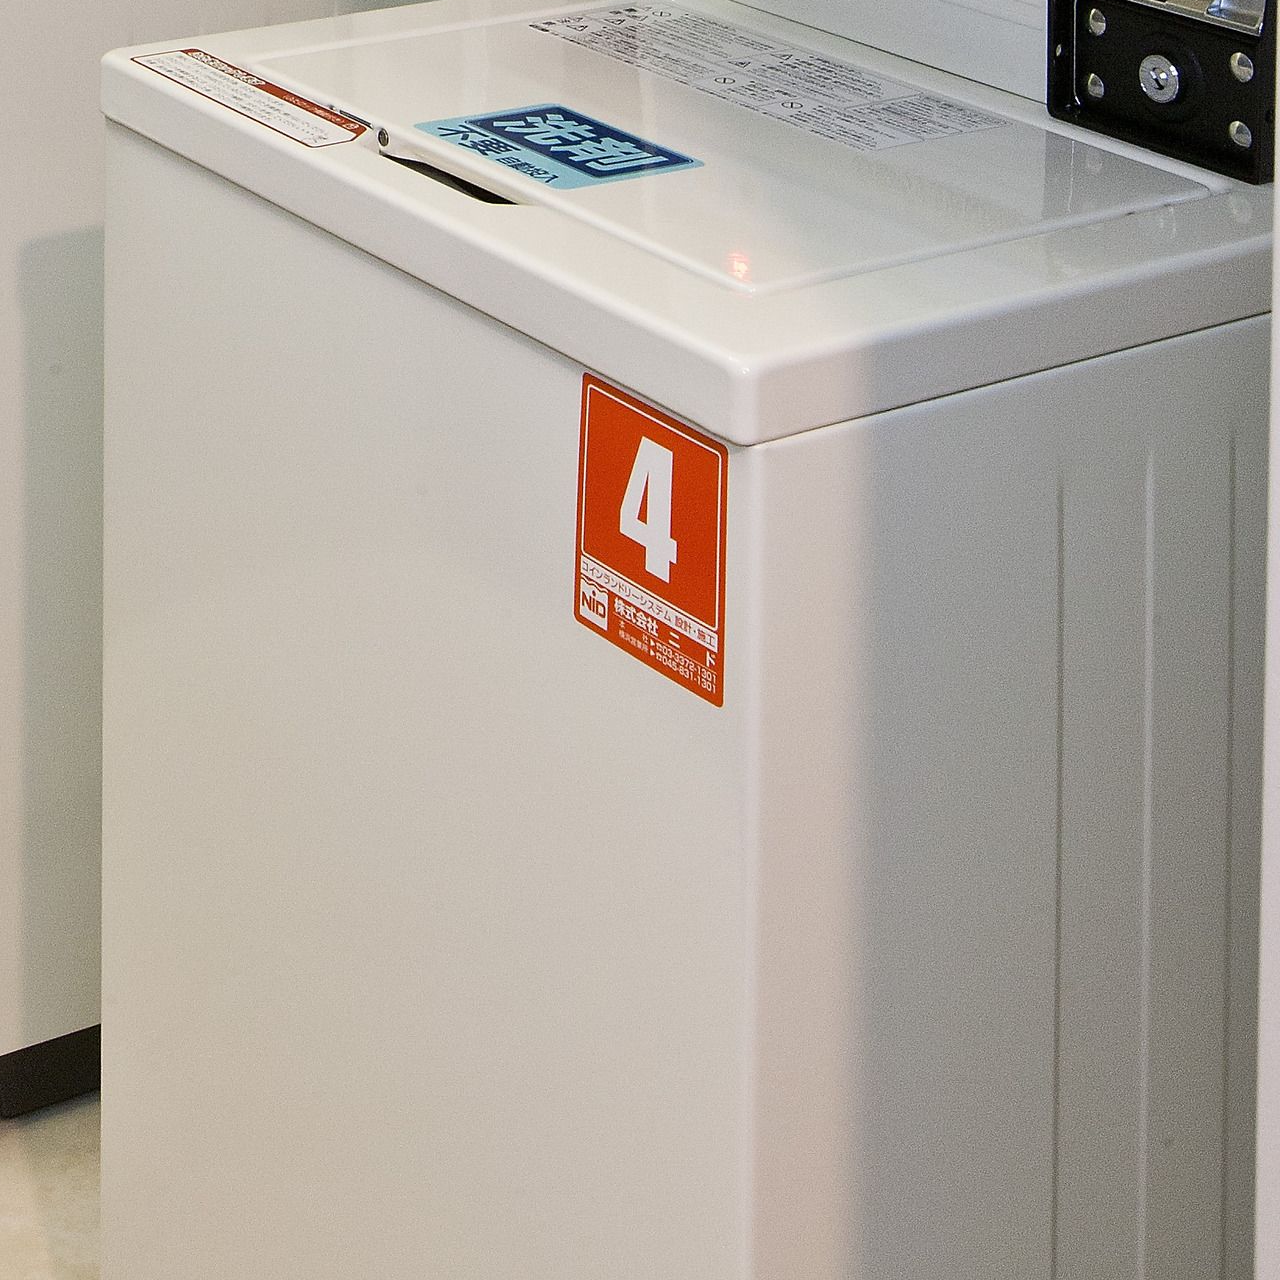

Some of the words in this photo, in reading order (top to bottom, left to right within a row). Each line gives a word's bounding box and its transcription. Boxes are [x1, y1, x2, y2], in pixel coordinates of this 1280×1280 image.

[437, 122, 522, 158] 不要
[492, 113, 669, 172] 洗剤
[495, 155, 559, 184] 自動投入
[619, 435, 677, 584] 4
[582, 560, 672, 623] コインランドリーシステム
[614, 598, 659, 637] 株式会社
